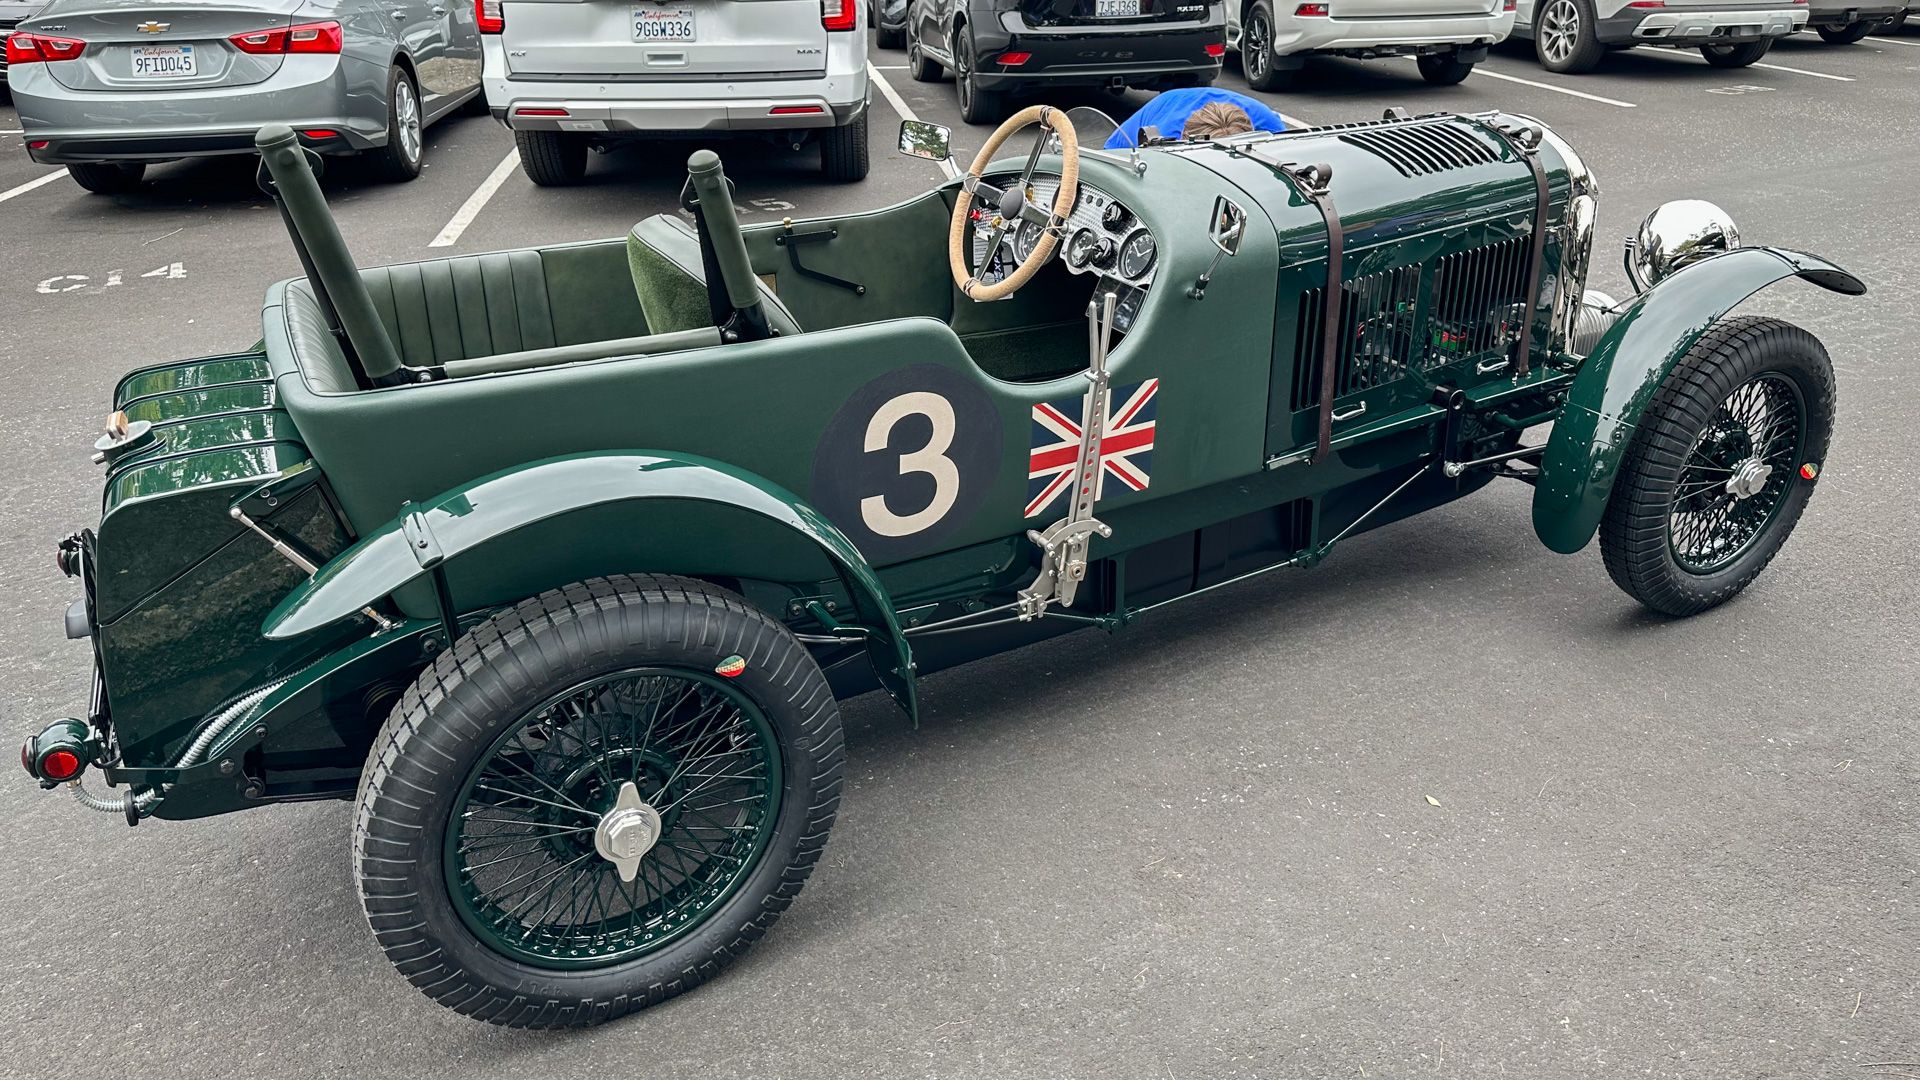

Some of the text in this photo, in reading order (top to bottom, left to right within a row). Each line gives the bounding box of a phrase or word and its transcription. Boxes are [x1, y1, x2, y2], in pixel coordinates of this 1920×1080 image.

[643, 10, 682, 21] California
[635, 21, 691, 37] 9GGW336
[143, 47, 182, 57] California
[135, 56, 192, 73] 9FID045
[35, 262, 188, 293] C14
[861, 391, 960, 537] 3
